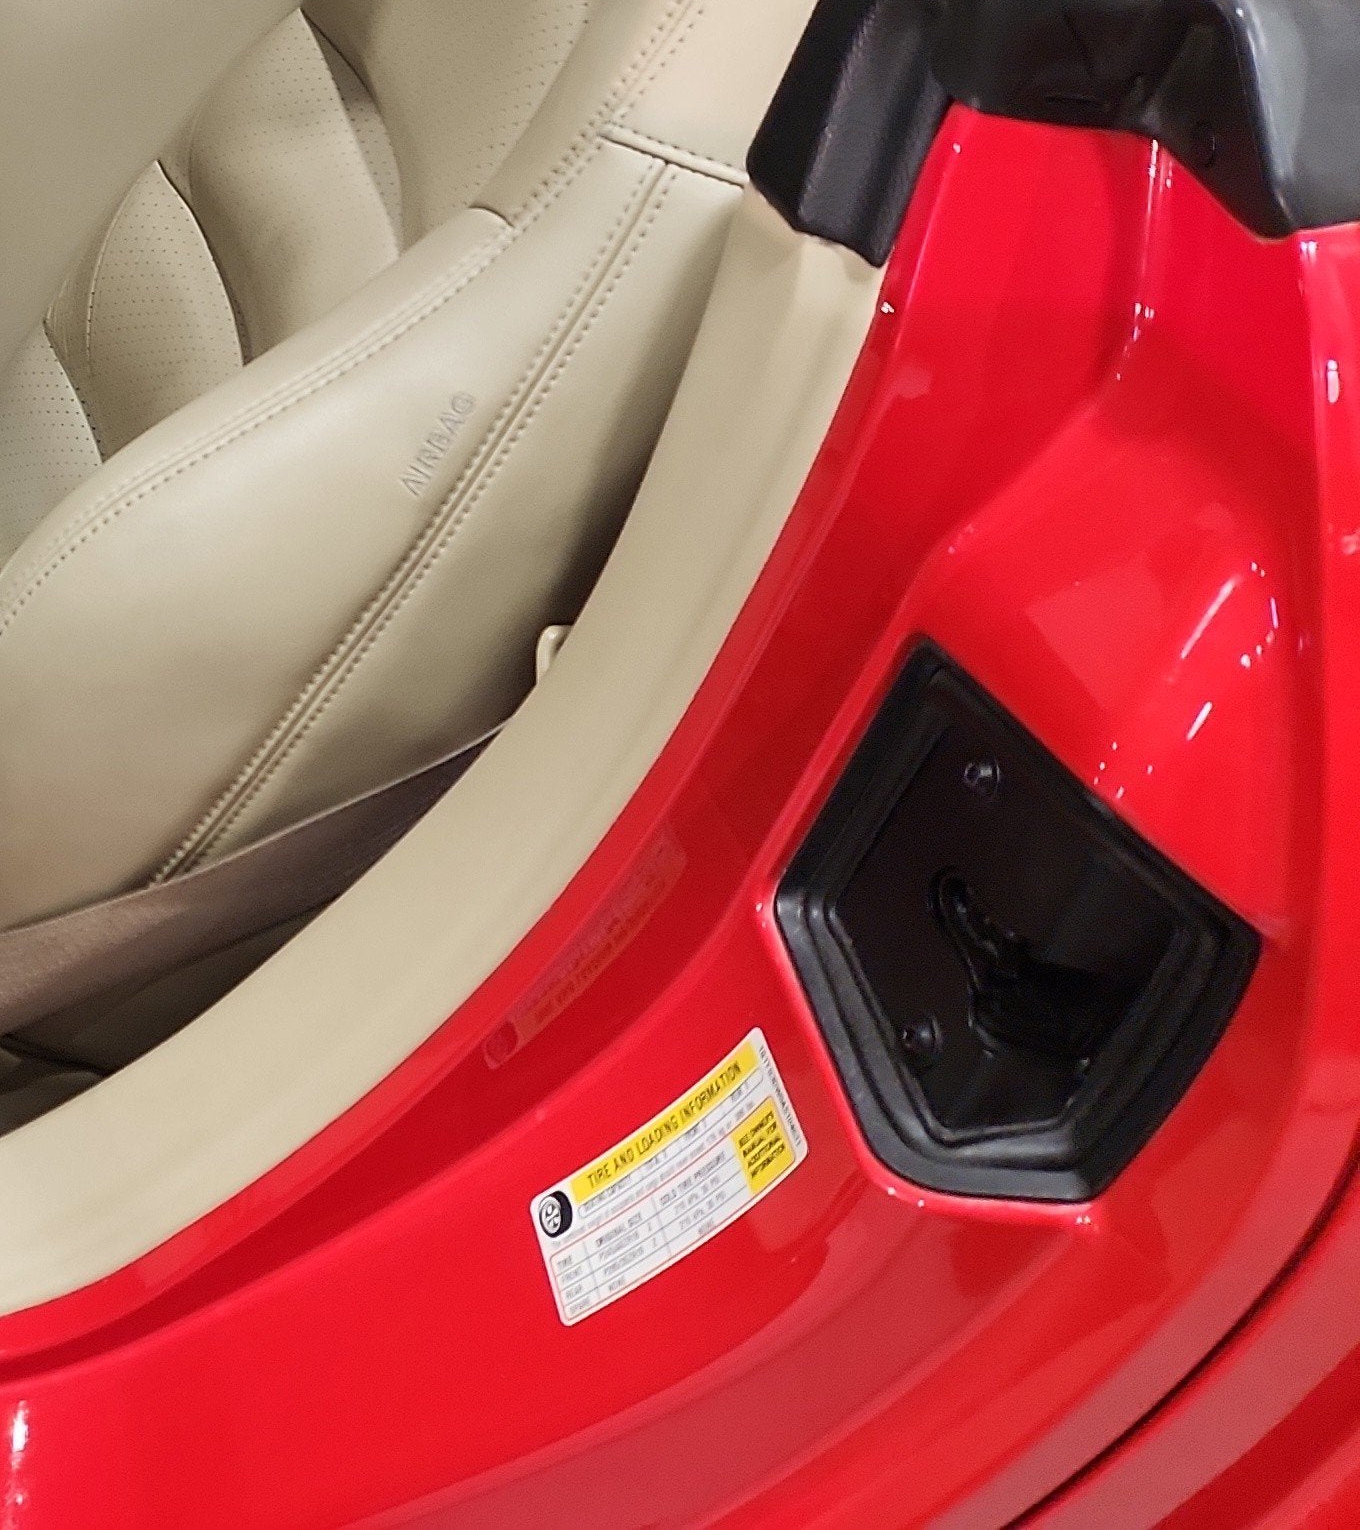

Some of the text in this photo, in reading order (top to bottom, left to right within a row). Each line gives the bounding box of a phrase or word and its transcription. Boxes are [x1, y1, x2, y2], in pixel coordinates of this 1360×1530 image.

[587, 1060, 741, 1189] TIRE AND LOADING INFORMATION
